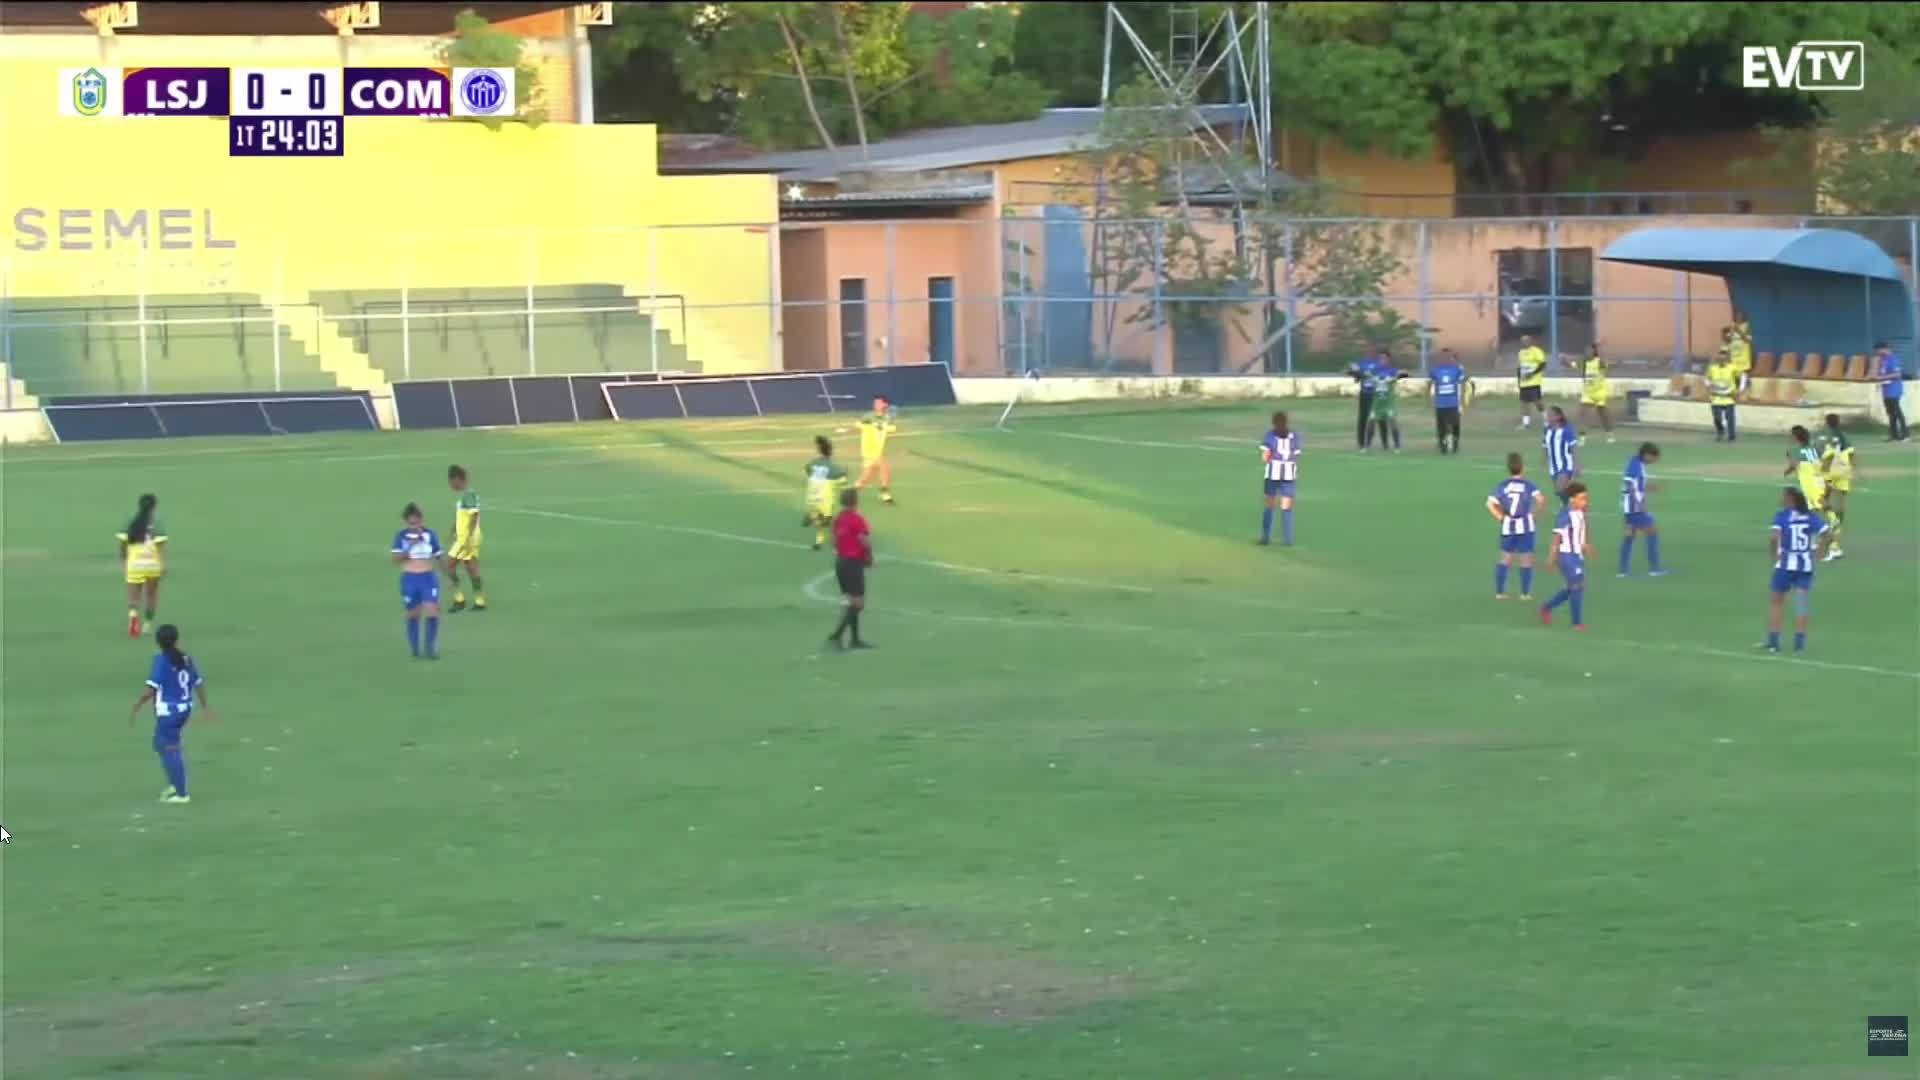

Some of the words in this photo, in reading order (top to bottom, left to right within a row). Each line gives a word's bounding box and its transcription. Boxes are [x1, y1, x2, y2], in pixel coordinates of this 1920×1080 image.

[14, 207, 236, 251] SEMEL
[1508, 493, 1521, 516] 7
[1789, 524, 1809, 550] 15
[178, 670, 189, 700] 9
